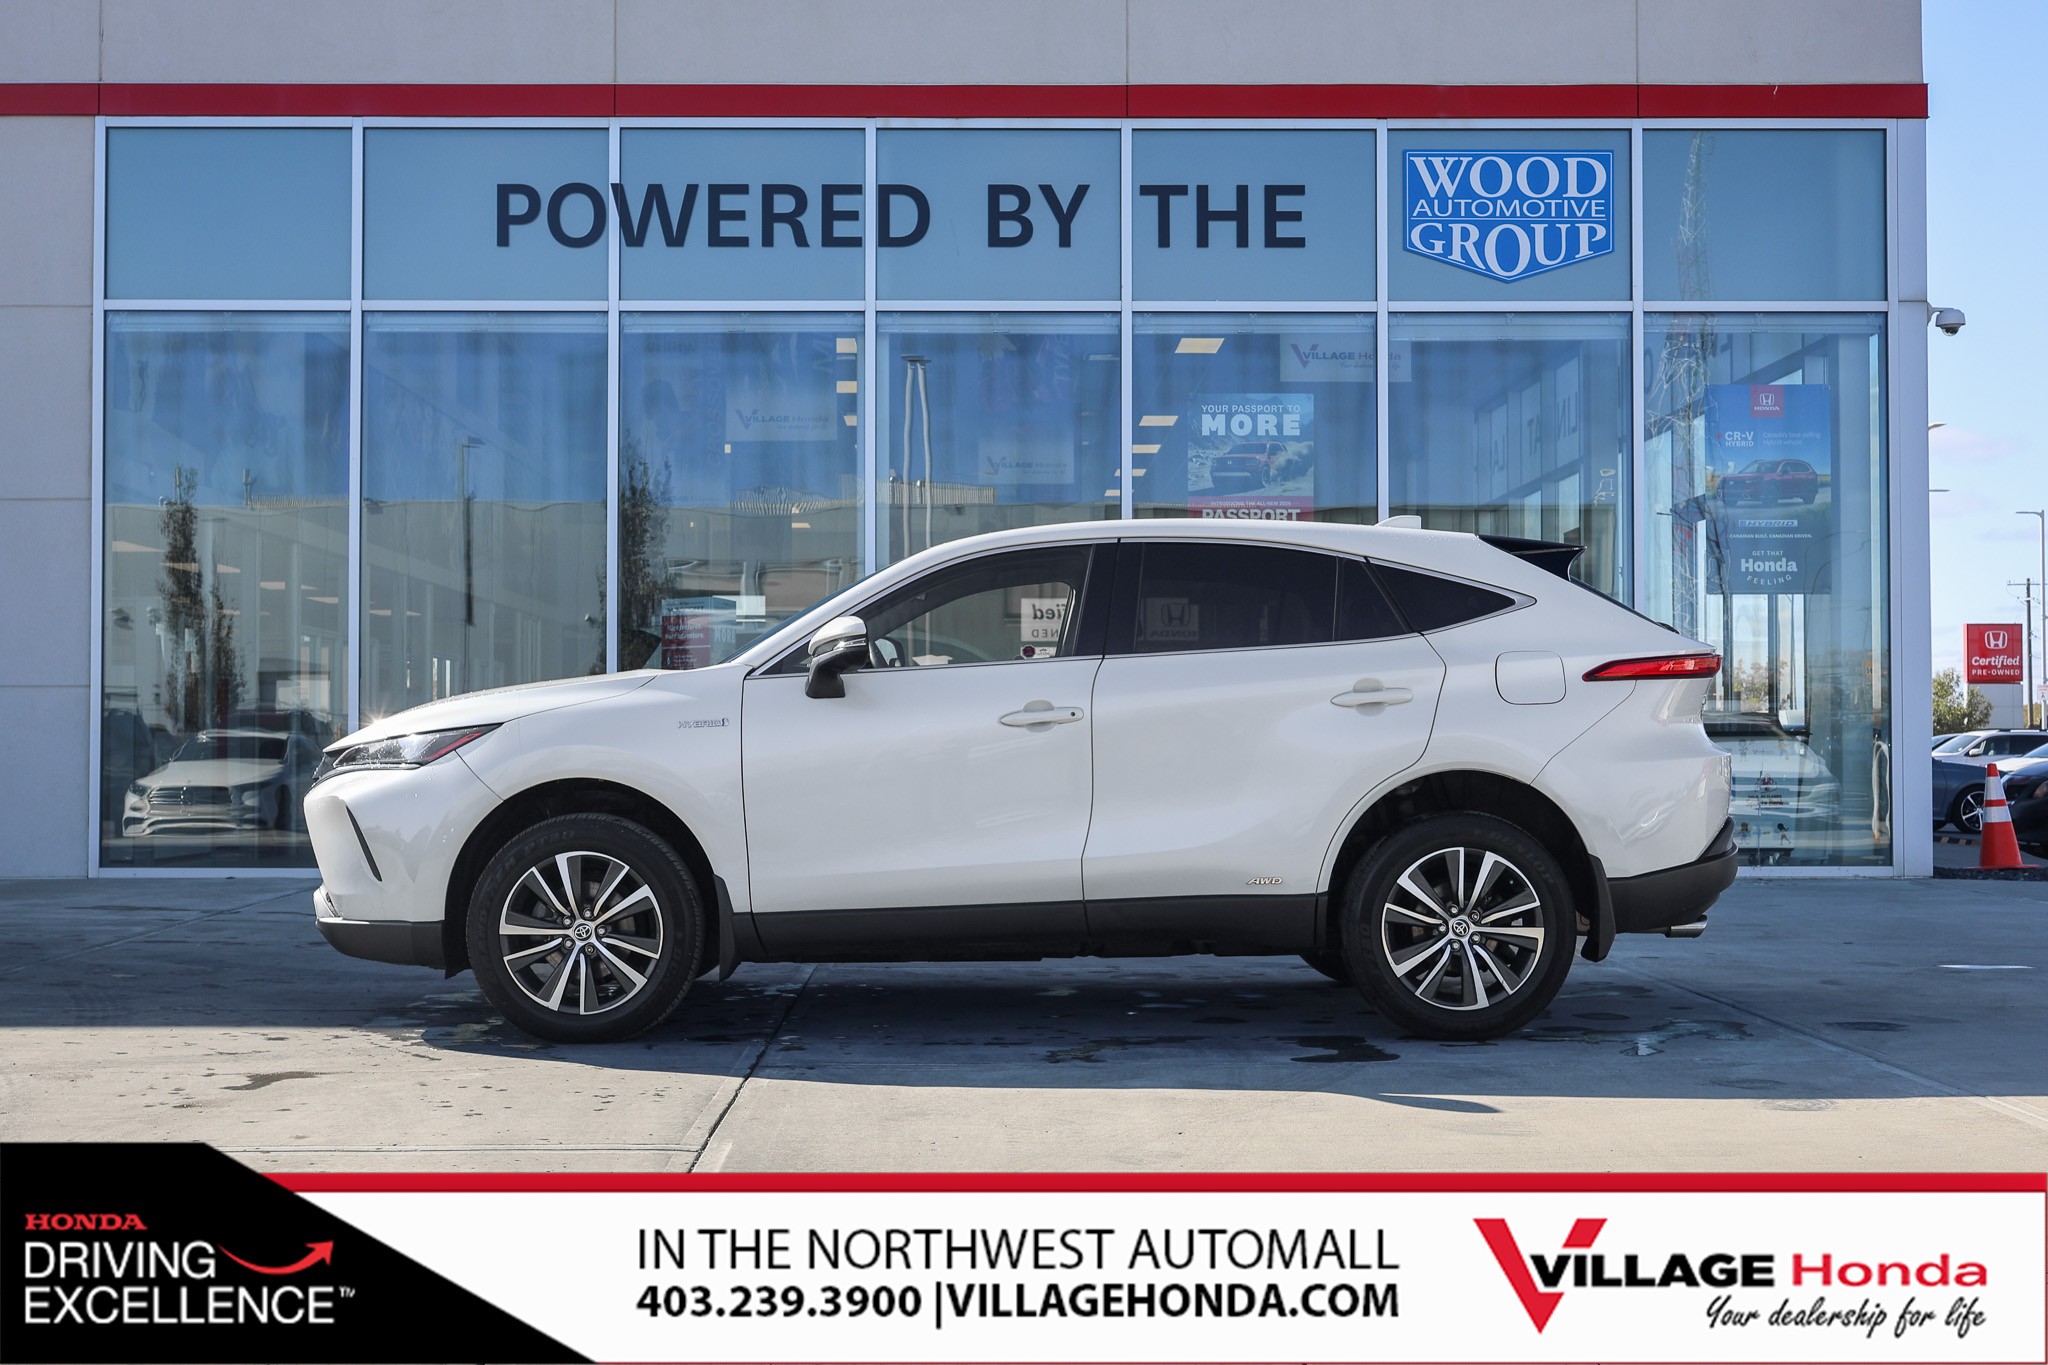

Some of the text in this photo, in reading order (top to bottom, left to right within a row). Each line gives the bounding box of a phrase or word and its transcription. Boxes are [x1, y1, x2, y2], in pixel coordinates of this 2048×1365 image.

[1410, 156, 1607, 198] WOOD
[1412, 199, 1606, 217] AUTOMOTIVE
[495, 183, 1306, 249] POWERED BY THE
[1410, 222, 1607, 277] GROUP
[1302, 352, 1401, 360] VILLAGE Hoda
[1202, 405, 1300, 413] YOUR PASSPORT TO
[745, 415, 790, 423] VILLAGE
[1202, 414, 1300, 436] MORE
[1725, 431, 1754, 440] CR-V
[994, 461, 1033, 469] VILLAGE
[1202, 509, 1300, 520] PASSPORT
[1741, 558, 1797, 572] Honda
[1747, 574, 1792, 585] FEELING
[1972, 655, 2020, 668] Certified
[677, 719, 721, 728] HYBRID
[1246, 876, 1283, 885] AWD
